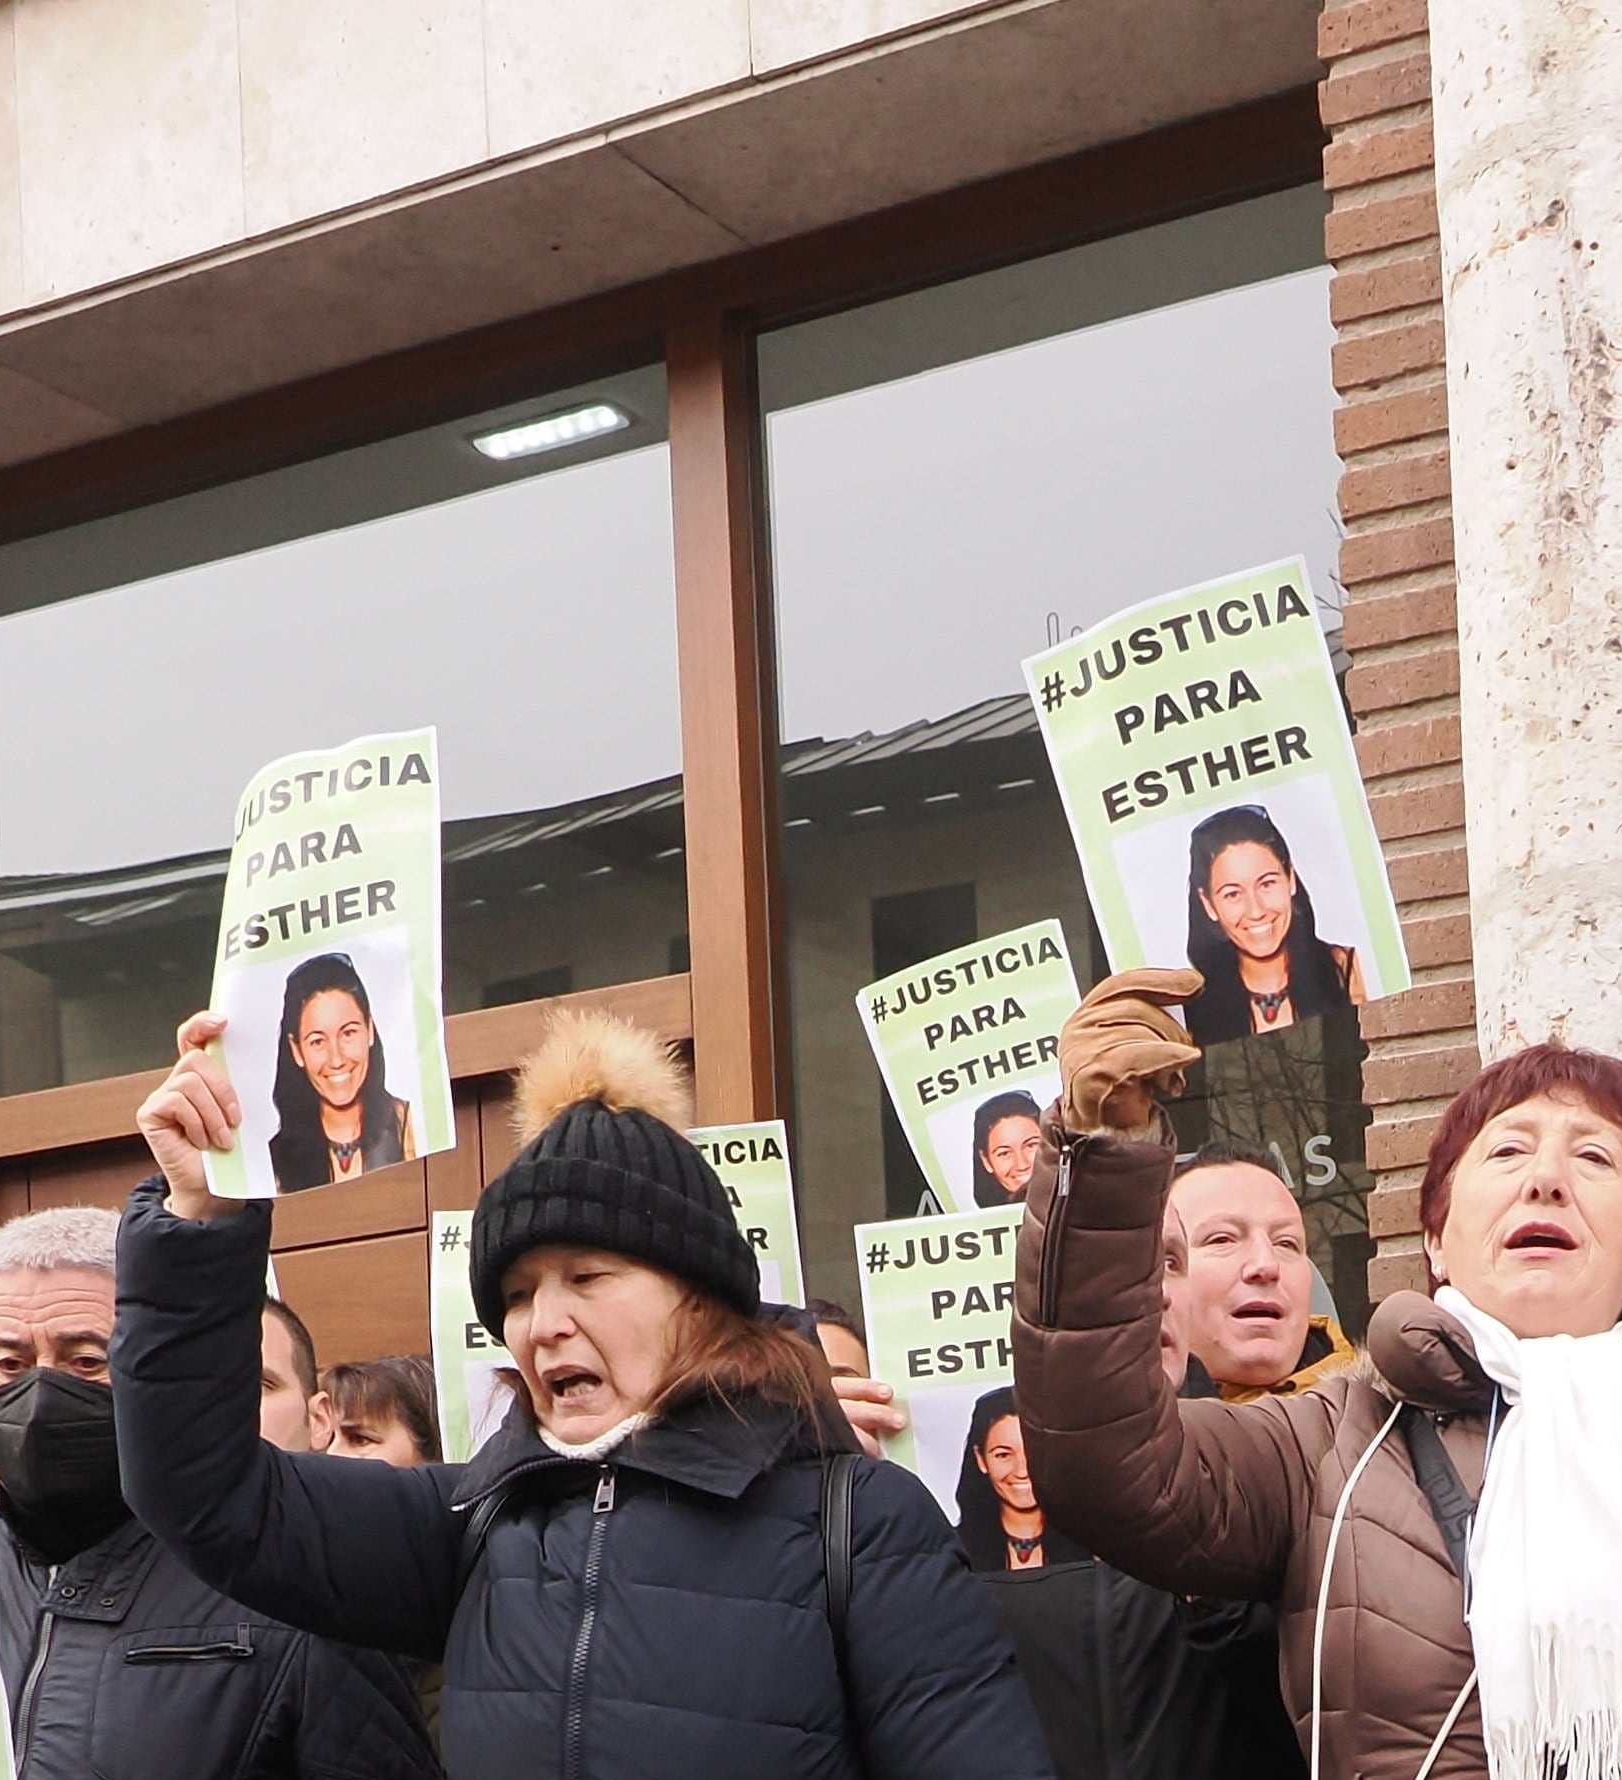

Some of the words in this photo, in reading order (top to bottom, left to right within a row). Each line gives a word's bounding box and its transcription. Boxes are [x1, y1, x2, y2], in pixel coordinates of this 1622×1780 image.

[1040, 584, 1309, 713] #JUSTICIA
[1114, 669, 1262, 745] PARA
[236, 753, 431, 841] JUSTICIA
[1102, 725, 1313, 824] ESTHER
[246, 823, 362, 888] PARA
[225, 879, 396, 960] ESTHER
[871, 936, 1063, 1024] #JUSTICIA
[923, 996, 1026, 1051] PARA
[916, 1033, 1059, 1105] ESTHER
[865, 1226, 1021, 1279] #JUST
[931, 1283, 1016, 1320] PAR
[908, 1338, 1015, 1377] ESTH
